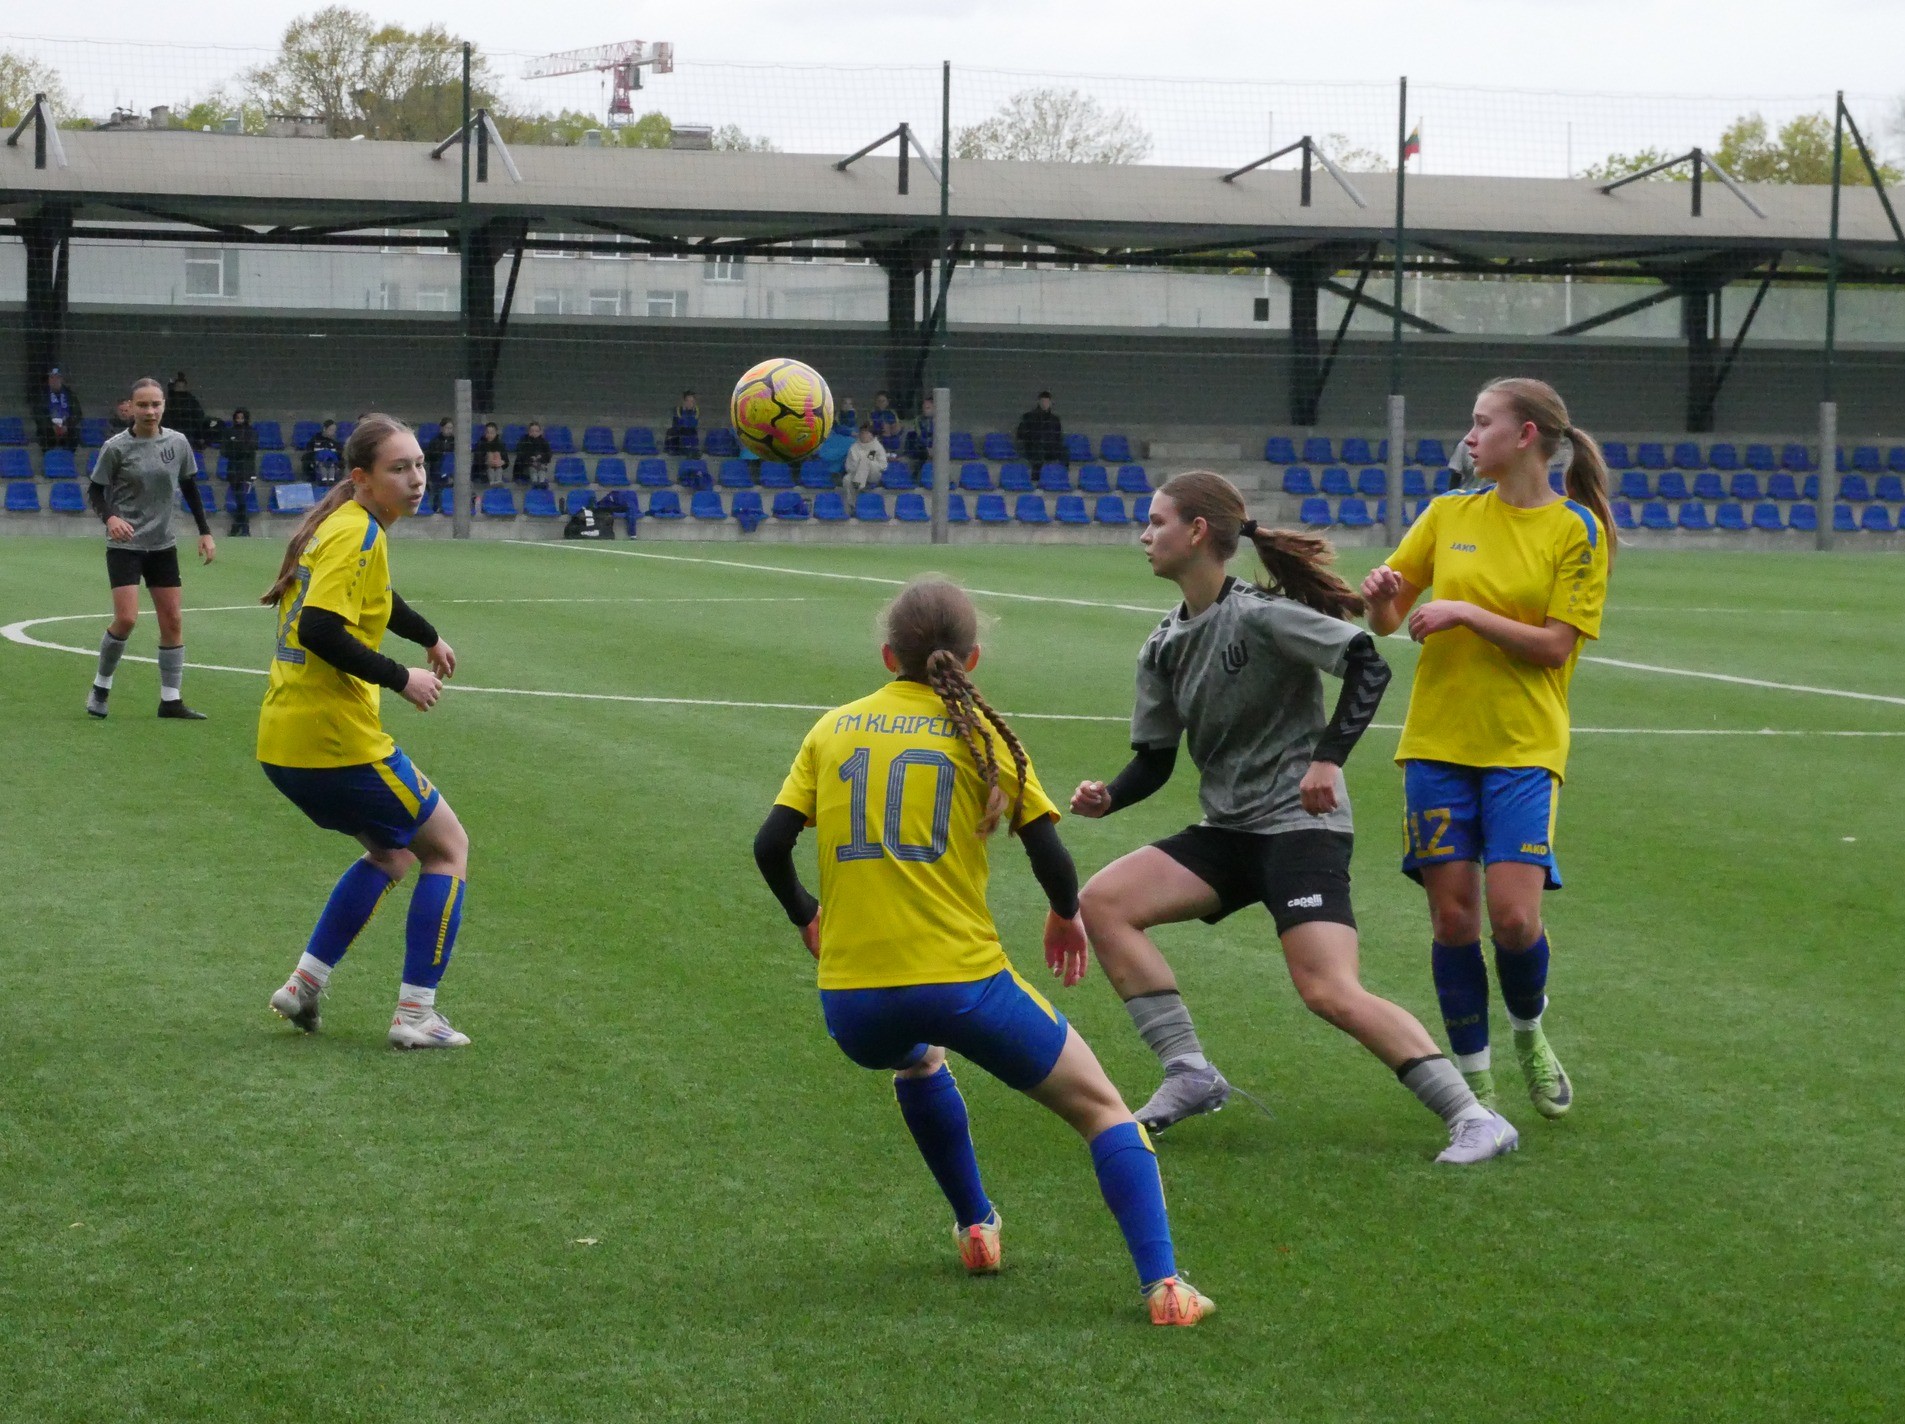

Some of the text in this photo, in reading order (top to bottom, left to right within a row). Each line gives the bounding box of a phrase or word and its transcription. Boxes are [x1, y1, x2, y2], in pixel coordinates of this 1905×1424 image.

[1450, 542, 1476, 553] JAKO
[834, 713, 961, 738] FM KLAIPĖD
[836, 747, 956, 863] 10
[1520, 842, 1548, 856] JAKO
